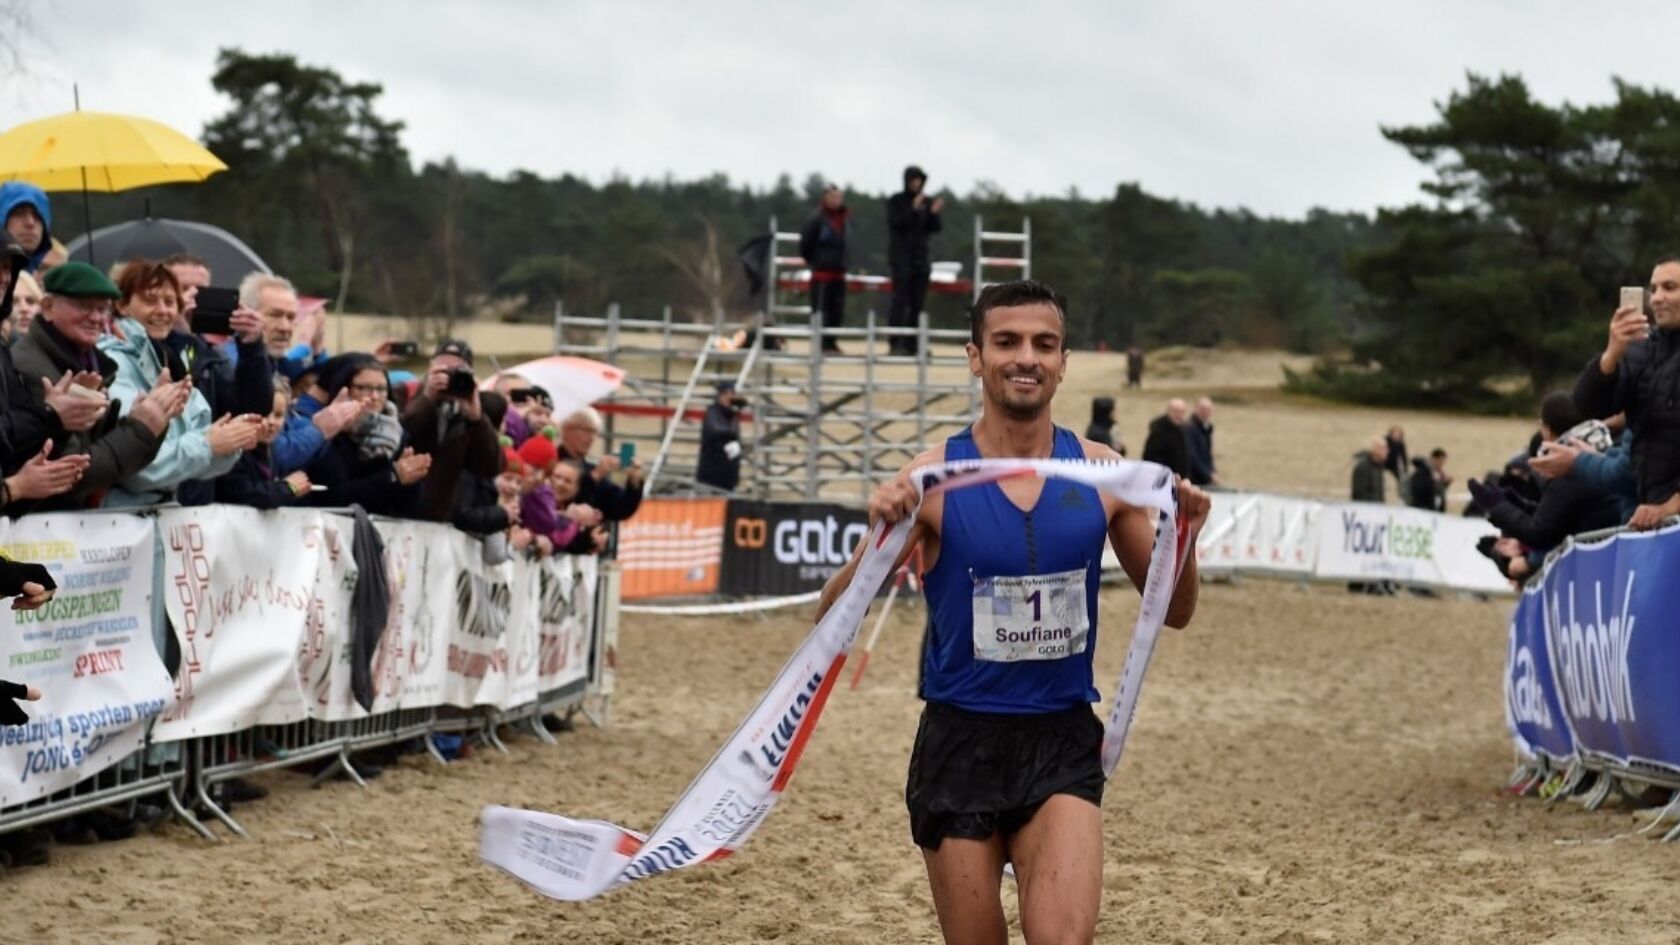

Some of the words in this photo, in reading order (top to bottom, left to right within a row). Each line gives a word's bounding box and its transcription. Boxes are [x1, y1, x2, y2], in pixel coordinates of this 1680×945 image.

[1026, 590, 1041, 622] 1
[996, 627, 1071, 643] Soufiane
[67, 705, 133, 739] sporten
